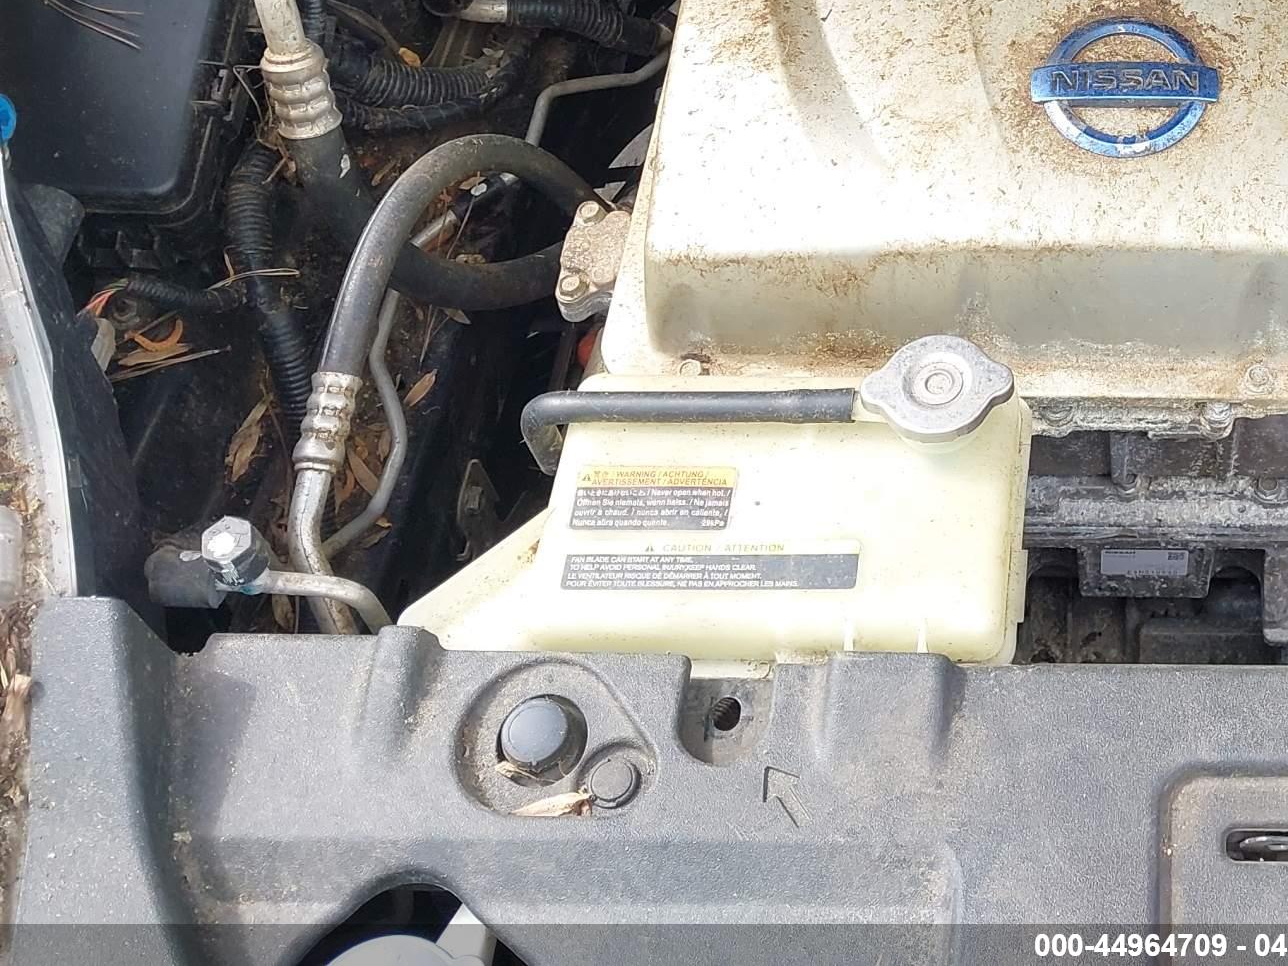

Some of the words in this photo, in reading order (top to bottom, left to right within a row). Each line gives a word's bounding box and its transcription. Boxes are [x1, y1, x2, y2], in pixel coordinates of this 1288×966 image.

[1052, 68, 1200, 93] NISSAN
[616, 470, 656, 478] WARNING
[663, 470, 704, 478] ACHTUNG
[592, 478, 661, 486] AVERTISSEMENT
[651, 489, 672, 497] Never
[673, 489, 691, 497] open
[662, 544, 712, 552] CAUTION
[724, 544, 785, 552] ATTENTION
